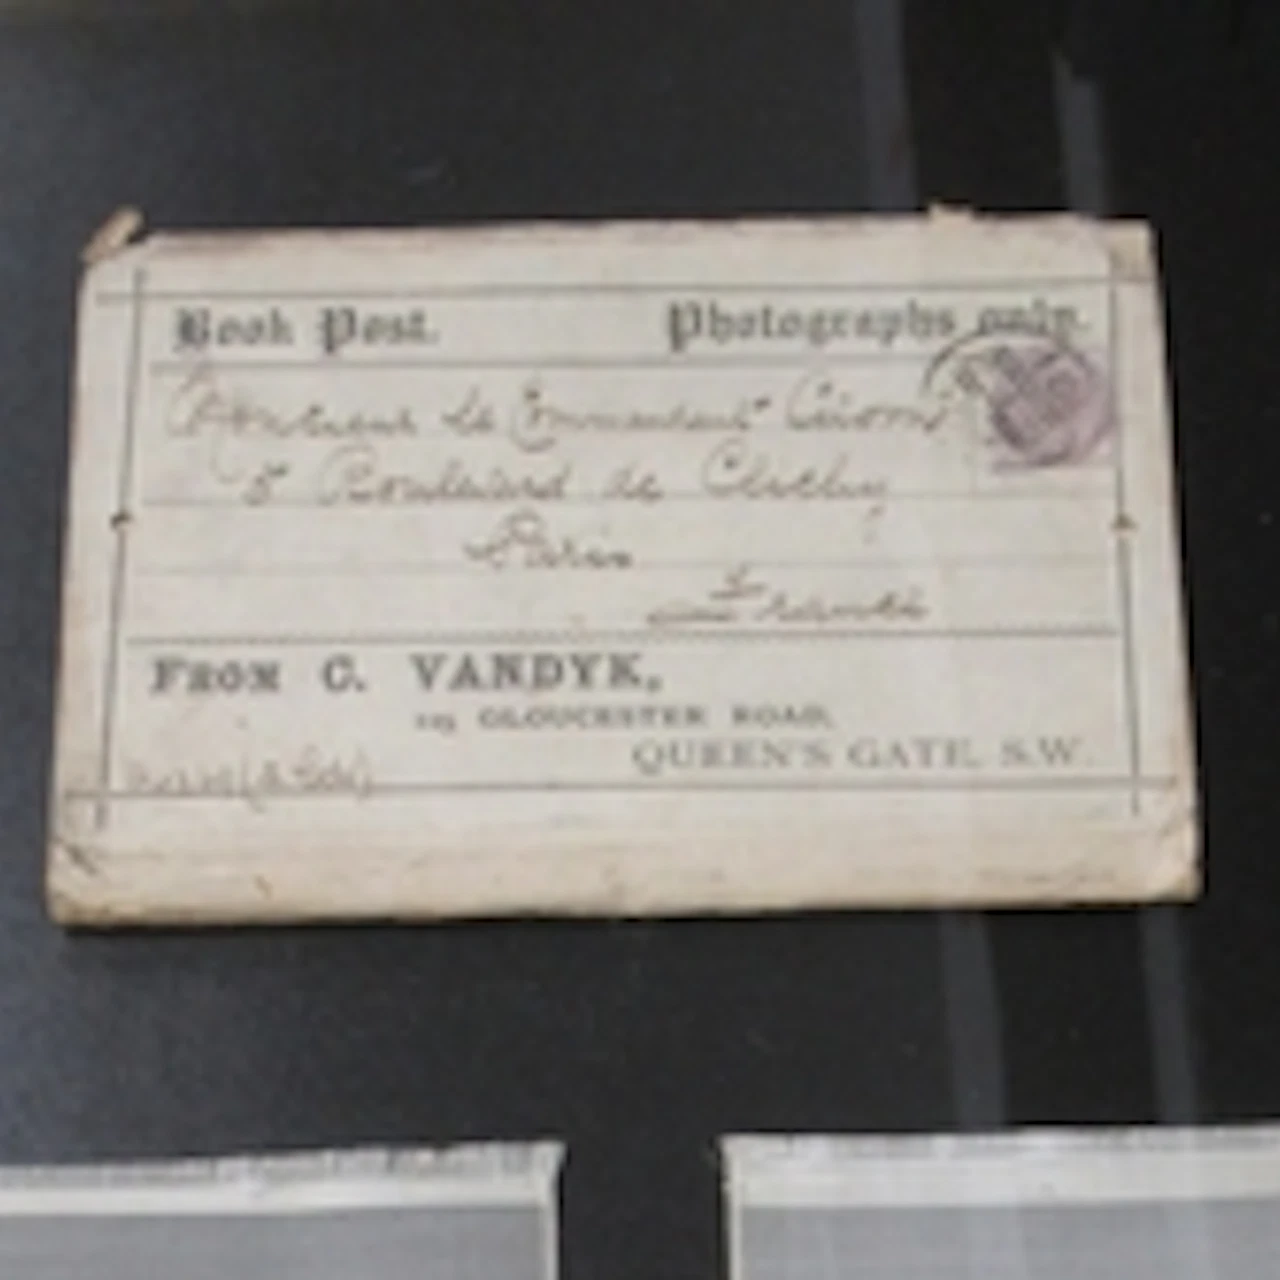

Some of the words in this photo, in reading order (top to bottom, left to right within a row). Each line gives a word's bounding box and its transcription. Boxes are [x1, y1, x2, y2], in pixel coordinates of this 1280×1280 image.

[172, 306, 295, 352] Book
[668, 300, 956, 352] Photographs
[321, 656, 368, 693] C.
[409, 652, 663, 694] VANDYK,
[477, 705, 709, 730] GLOUCESTER
[631, 737, 834, 776] QUEEN'S
